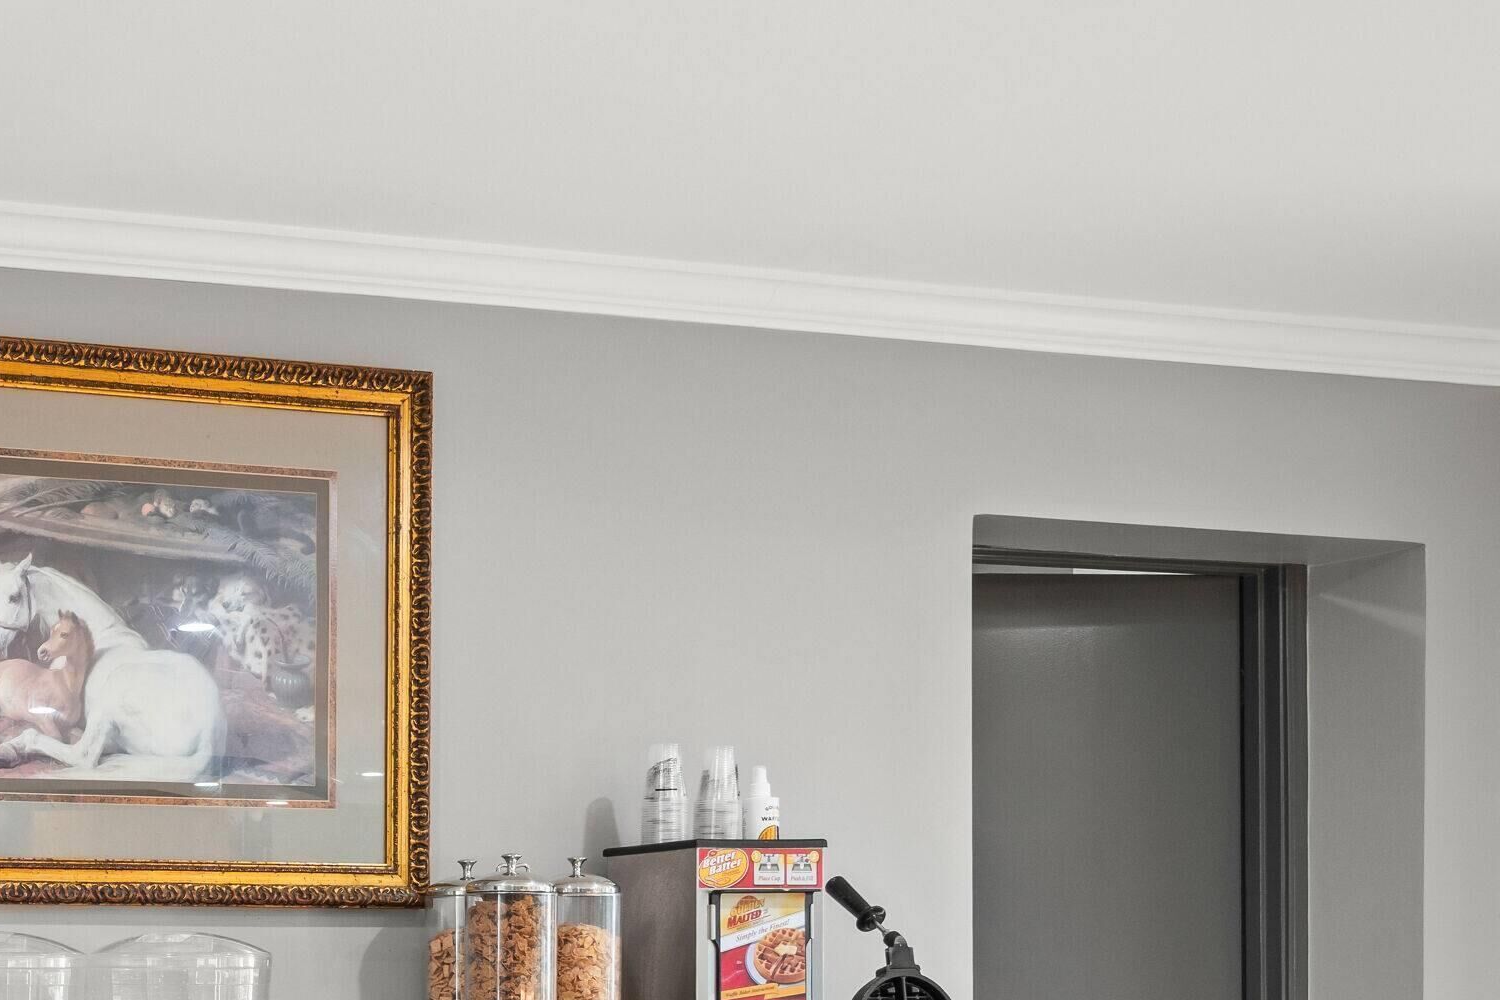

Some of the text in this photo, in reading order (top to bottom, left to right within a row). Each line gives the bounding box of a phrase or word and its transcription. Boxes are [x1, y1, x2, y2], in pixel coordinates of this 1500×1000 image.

[703, 851, 737, 868] Better
[709, 858, 742, 876] Batter
[726, 909, 762, 928] MALTED
[735, 930, 758, 943] Simply
[758, 926, 768, 935] the
